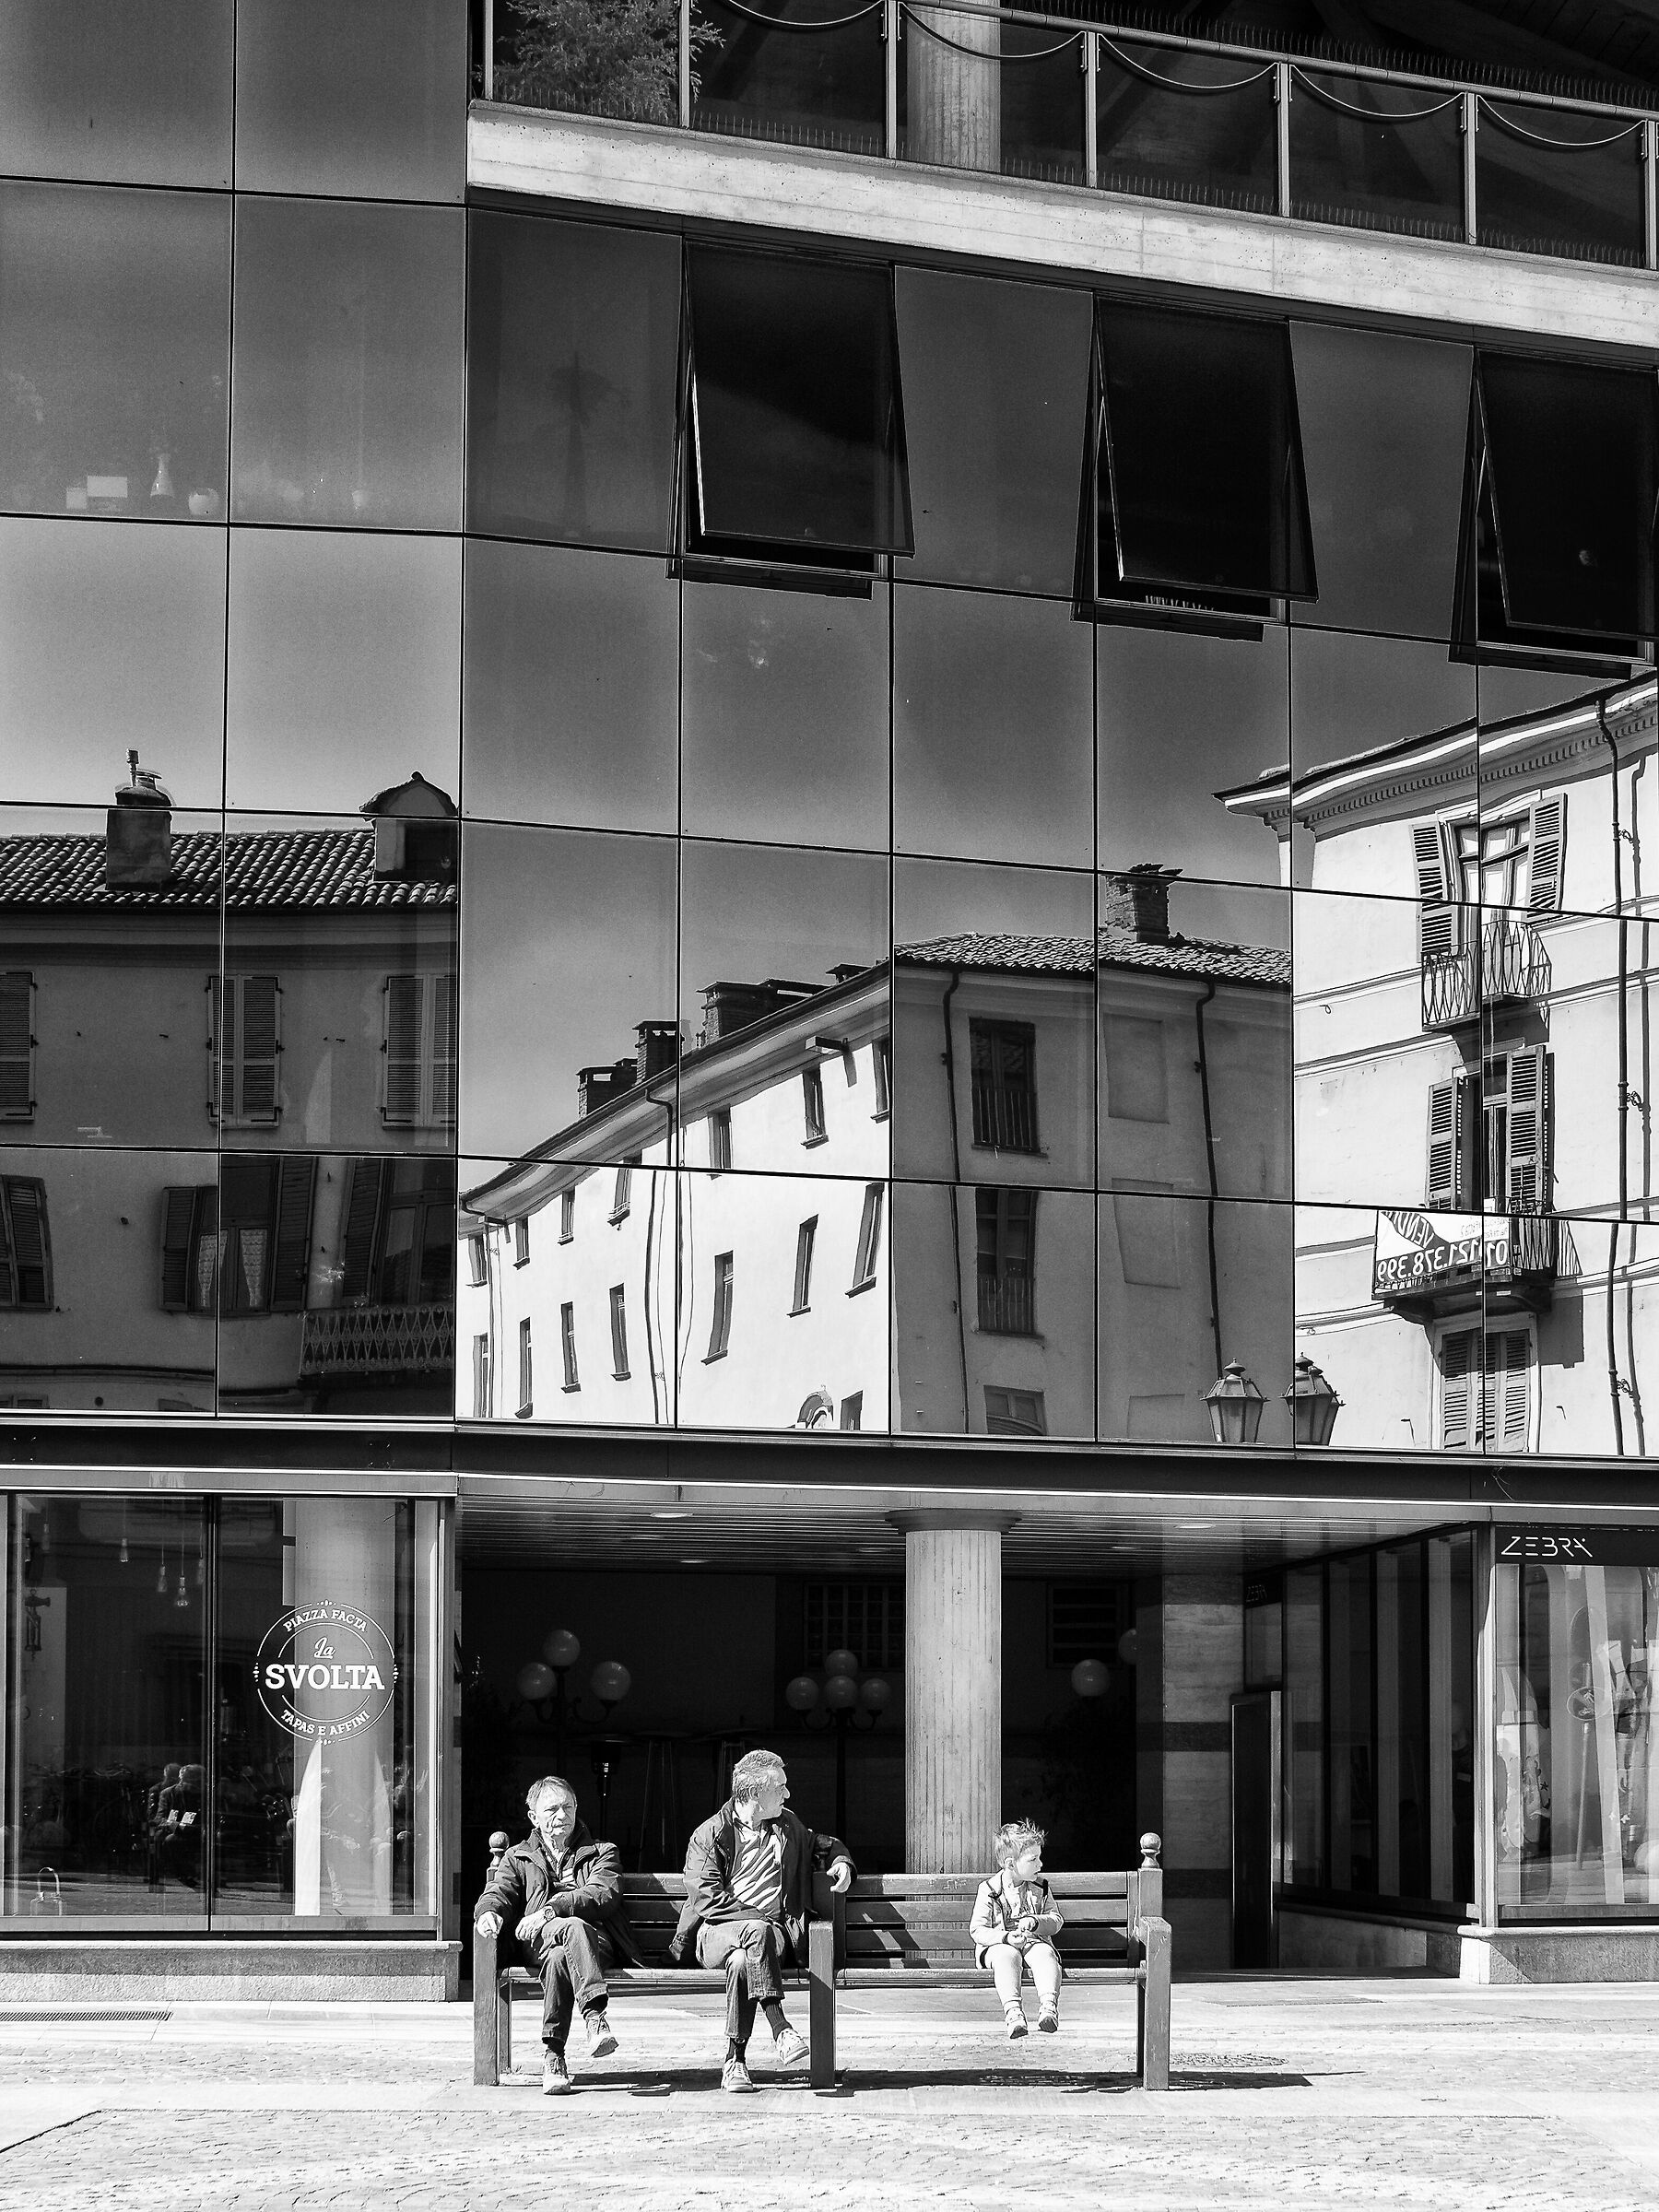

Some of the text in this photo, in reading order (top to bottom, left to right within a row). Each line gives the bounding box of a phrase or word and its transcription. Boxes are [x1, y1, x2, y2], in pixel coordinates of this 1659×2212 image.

[1500, 1535, 1594, 1558] ZEBRA
[283, 1608, 368, 1632] PIAZZA FACTA
[313, 1637, 336, 1659] La
[265, 1664, 385, 1690] SVOLTA
[280, 1709, 371, 1736] TAPAS E AFFINI
